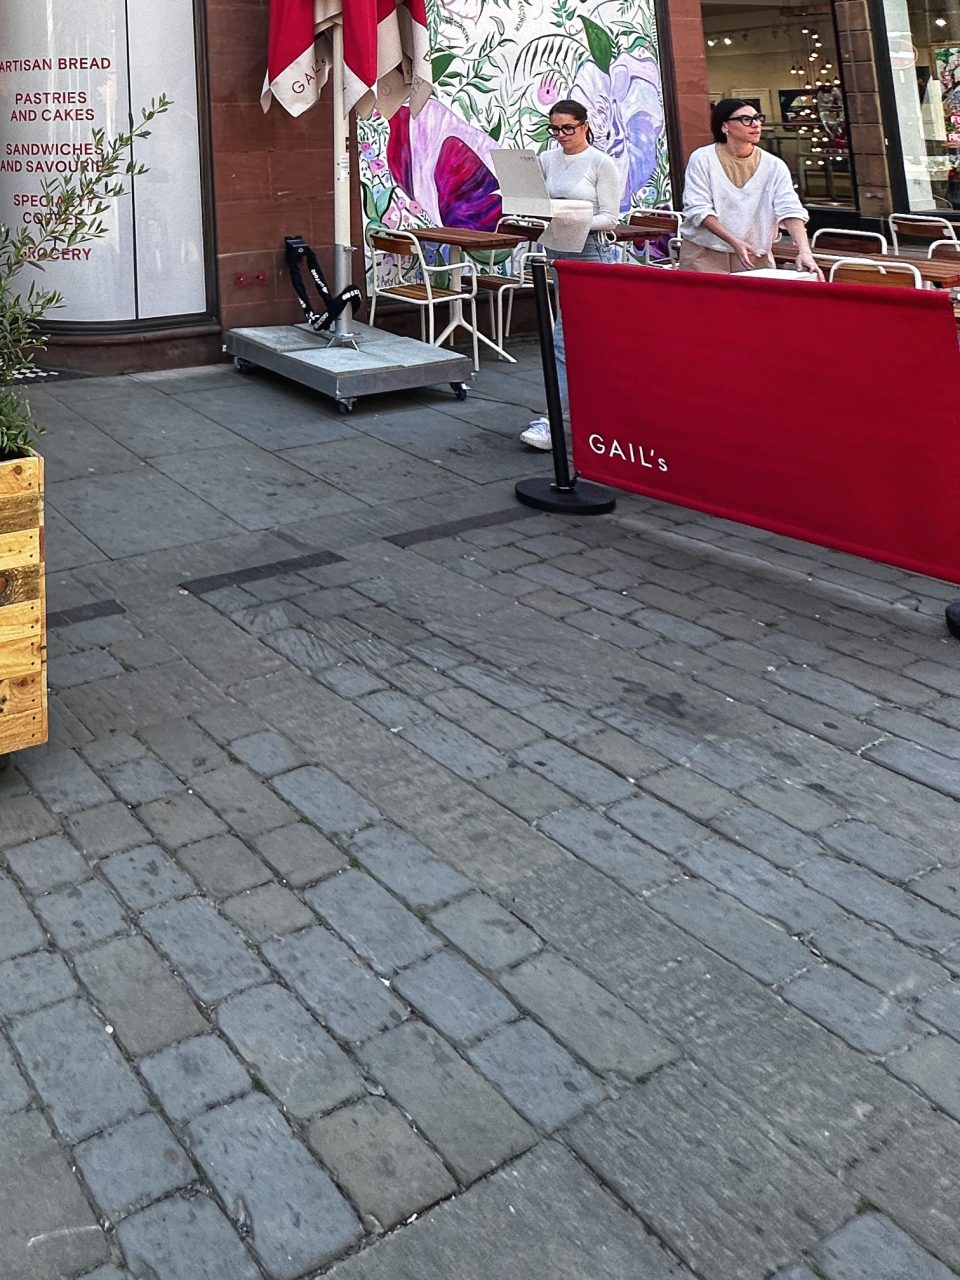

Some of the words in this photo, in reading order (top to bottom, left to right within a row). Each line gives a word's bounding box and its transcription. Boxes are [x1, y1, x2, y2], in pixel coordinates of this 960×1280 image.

[0, 58, 53, 73] ARTISAN
[58, 57, 111, 70] BREAD
[15, 91, 88, 105] PASTRIES
[10, 109, 37, 122] AND
[41, 108, 95, 122] CAKES
[6, 142, 104, 156] SANDWICHES
[0, 160, 22, 173] AND
[26, 160, 107, 173] SAVOURIE
[588, 433, 668, 472] GAIL's
